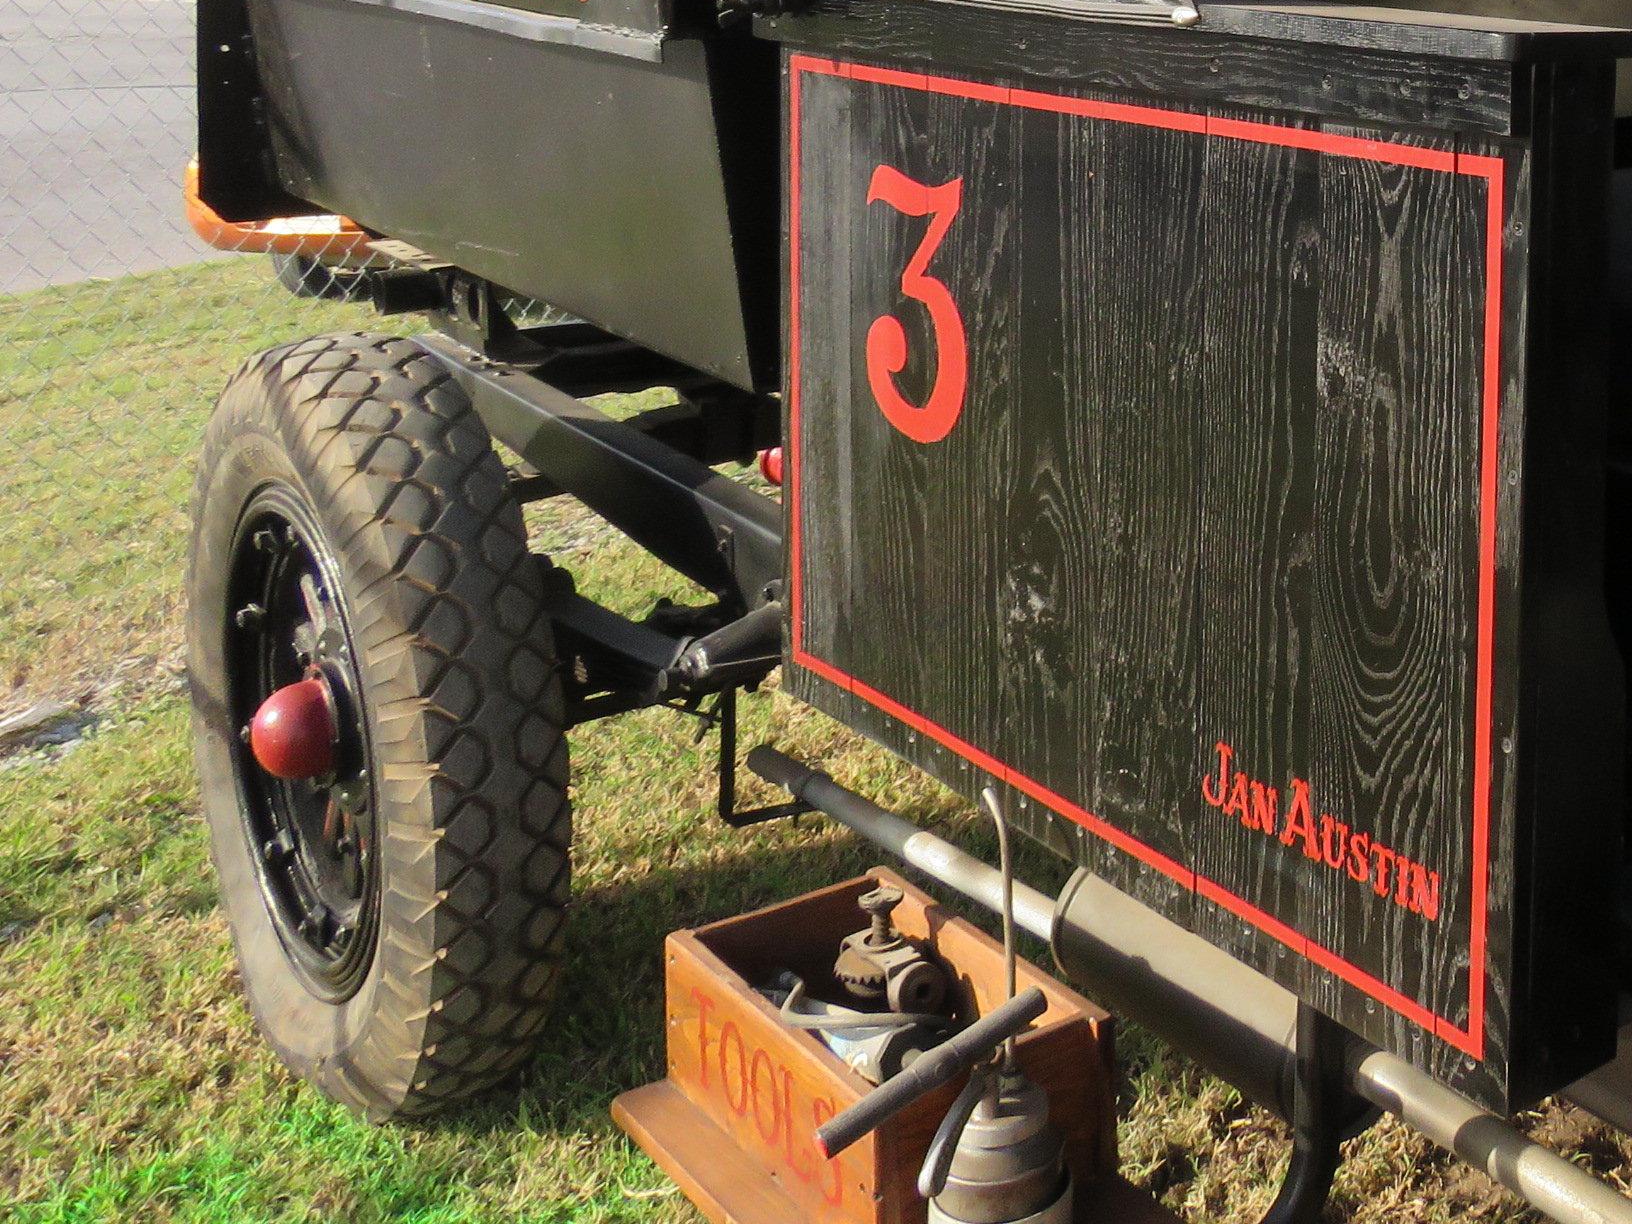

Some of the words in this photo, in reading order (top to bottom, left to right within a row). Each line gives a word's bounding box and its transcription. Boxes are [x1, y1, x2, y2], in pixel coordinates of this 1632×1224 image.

[865, 163, 968, 444] 3
[1202, 740, 1278, 836] JAN
[1278, 777, 1441, 922] AUSTIN
[691, 986, 844, 1208] TOOLS
